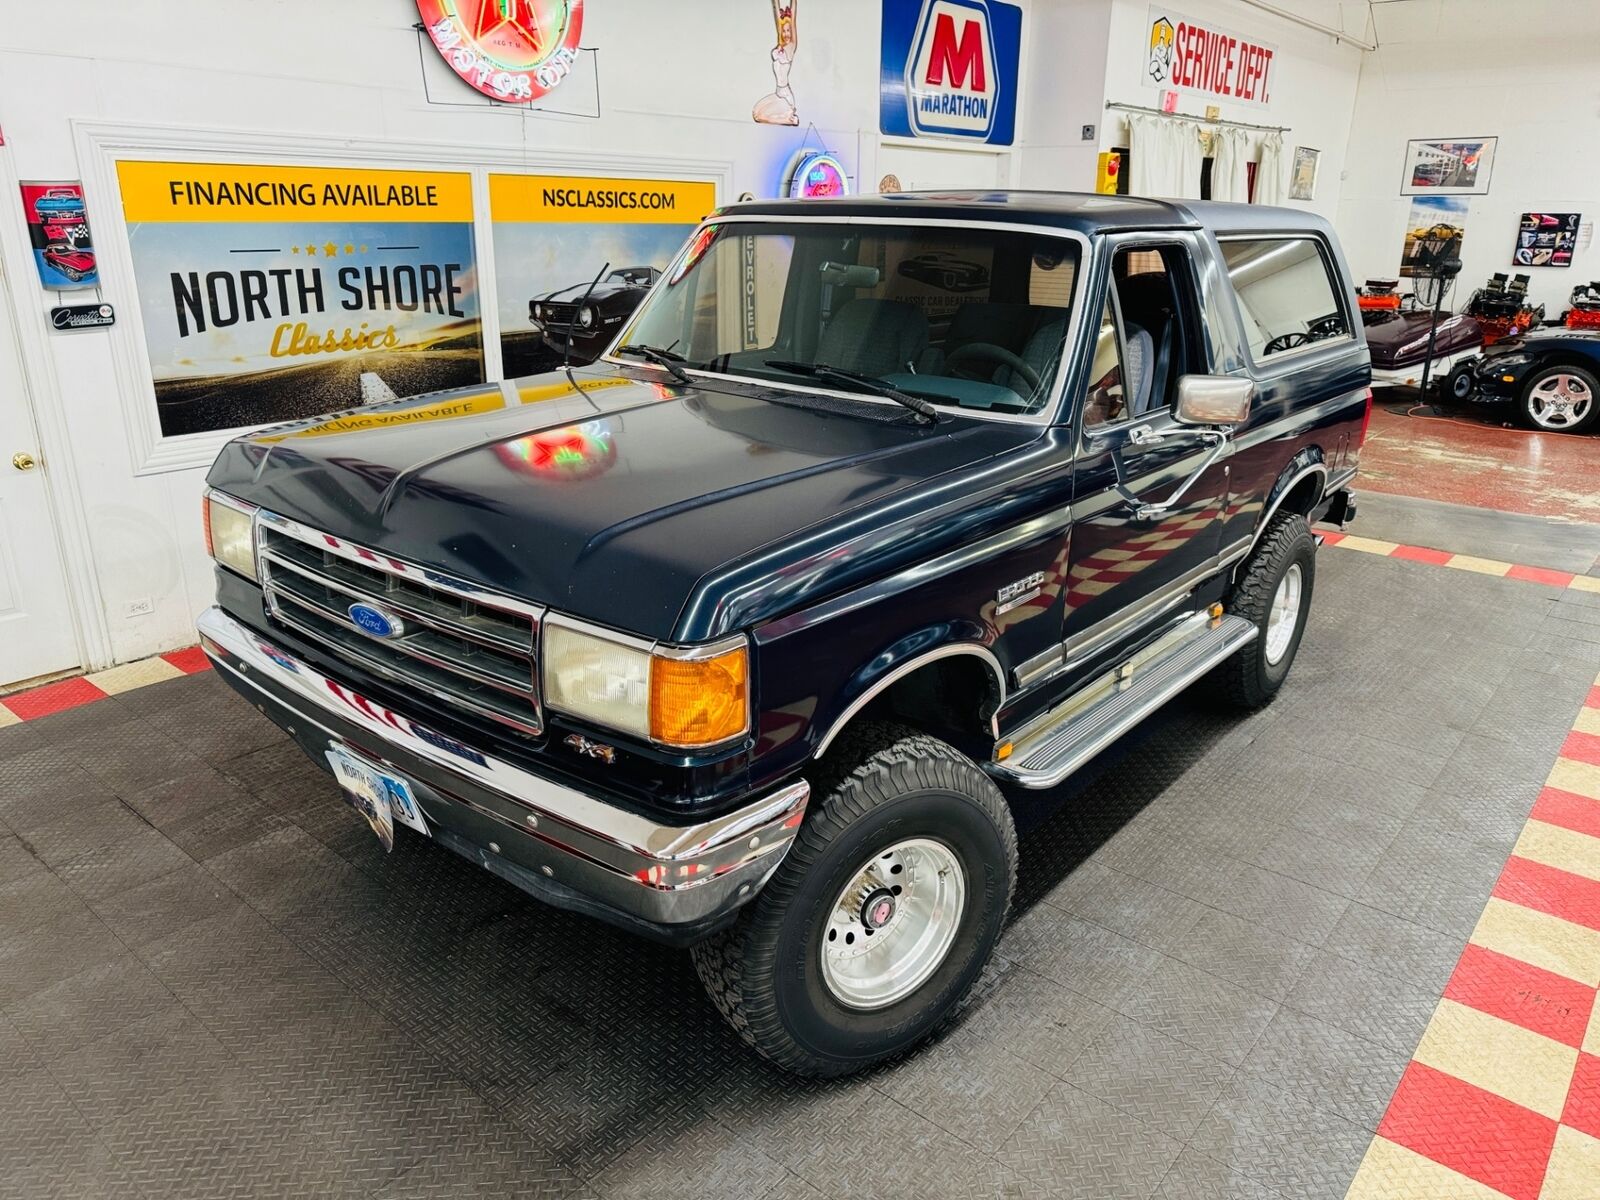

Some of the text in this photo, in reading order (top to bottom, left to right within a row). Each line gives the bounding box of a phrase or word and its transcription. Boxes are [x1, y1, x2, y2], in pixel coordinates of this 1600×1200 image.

[430, 18, 532, 98] MOTOR
[925, 13, 986, 92] M
[1172, 22, 1273, 104] SERVICE DEPT.
[920, 92, 988, 119] MARATHON
[168, 180, 438, 206] FINANCING AVAILABLE
[542, 188, 675, 210] NSCLASSICS.COM
[170, 264, 465, 338] NORTH SHORE
[270, 321, 401, 359] Classics
[359, 609, 382, 631] Ford
